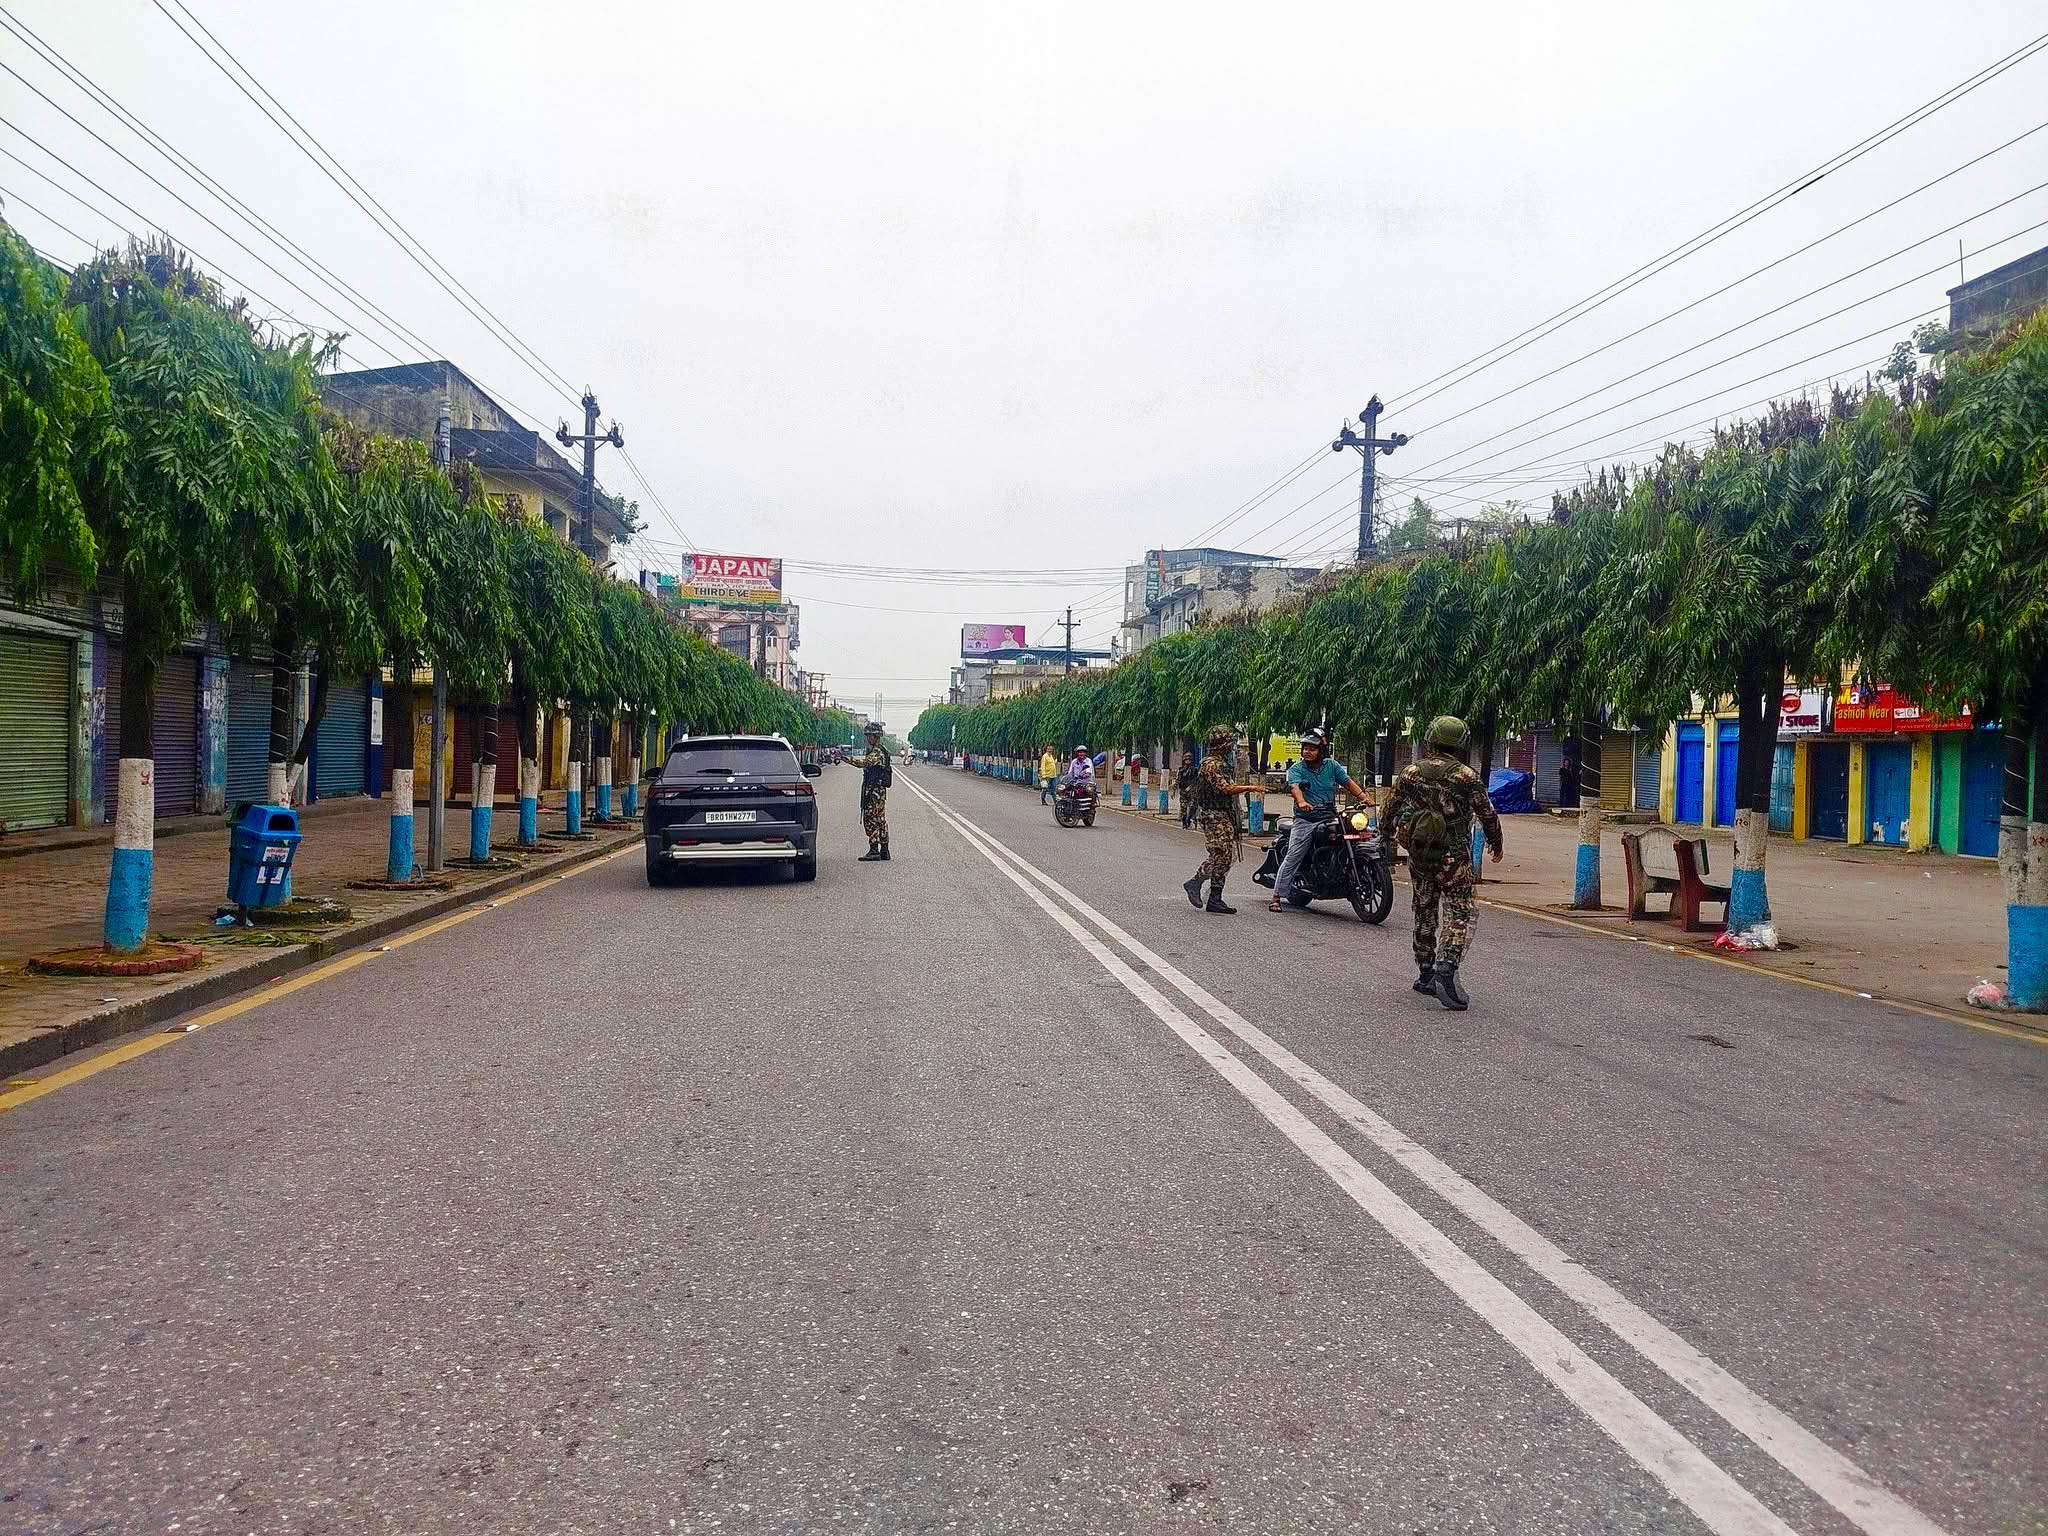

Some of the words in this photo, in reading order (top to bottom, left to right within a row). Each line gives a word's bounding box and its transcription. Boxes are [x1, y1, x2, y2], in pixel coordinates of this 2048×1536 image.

[696, 558, 767, 577] JAPAN
[694, 587, 726, 597] THIRD
[728, 588, 749, 598] EYE
[1834, 705, 1865, 719] Fashion
[1868, 705, 1889, 719] Wear
[1785, 714, 1819, 728] STORE
